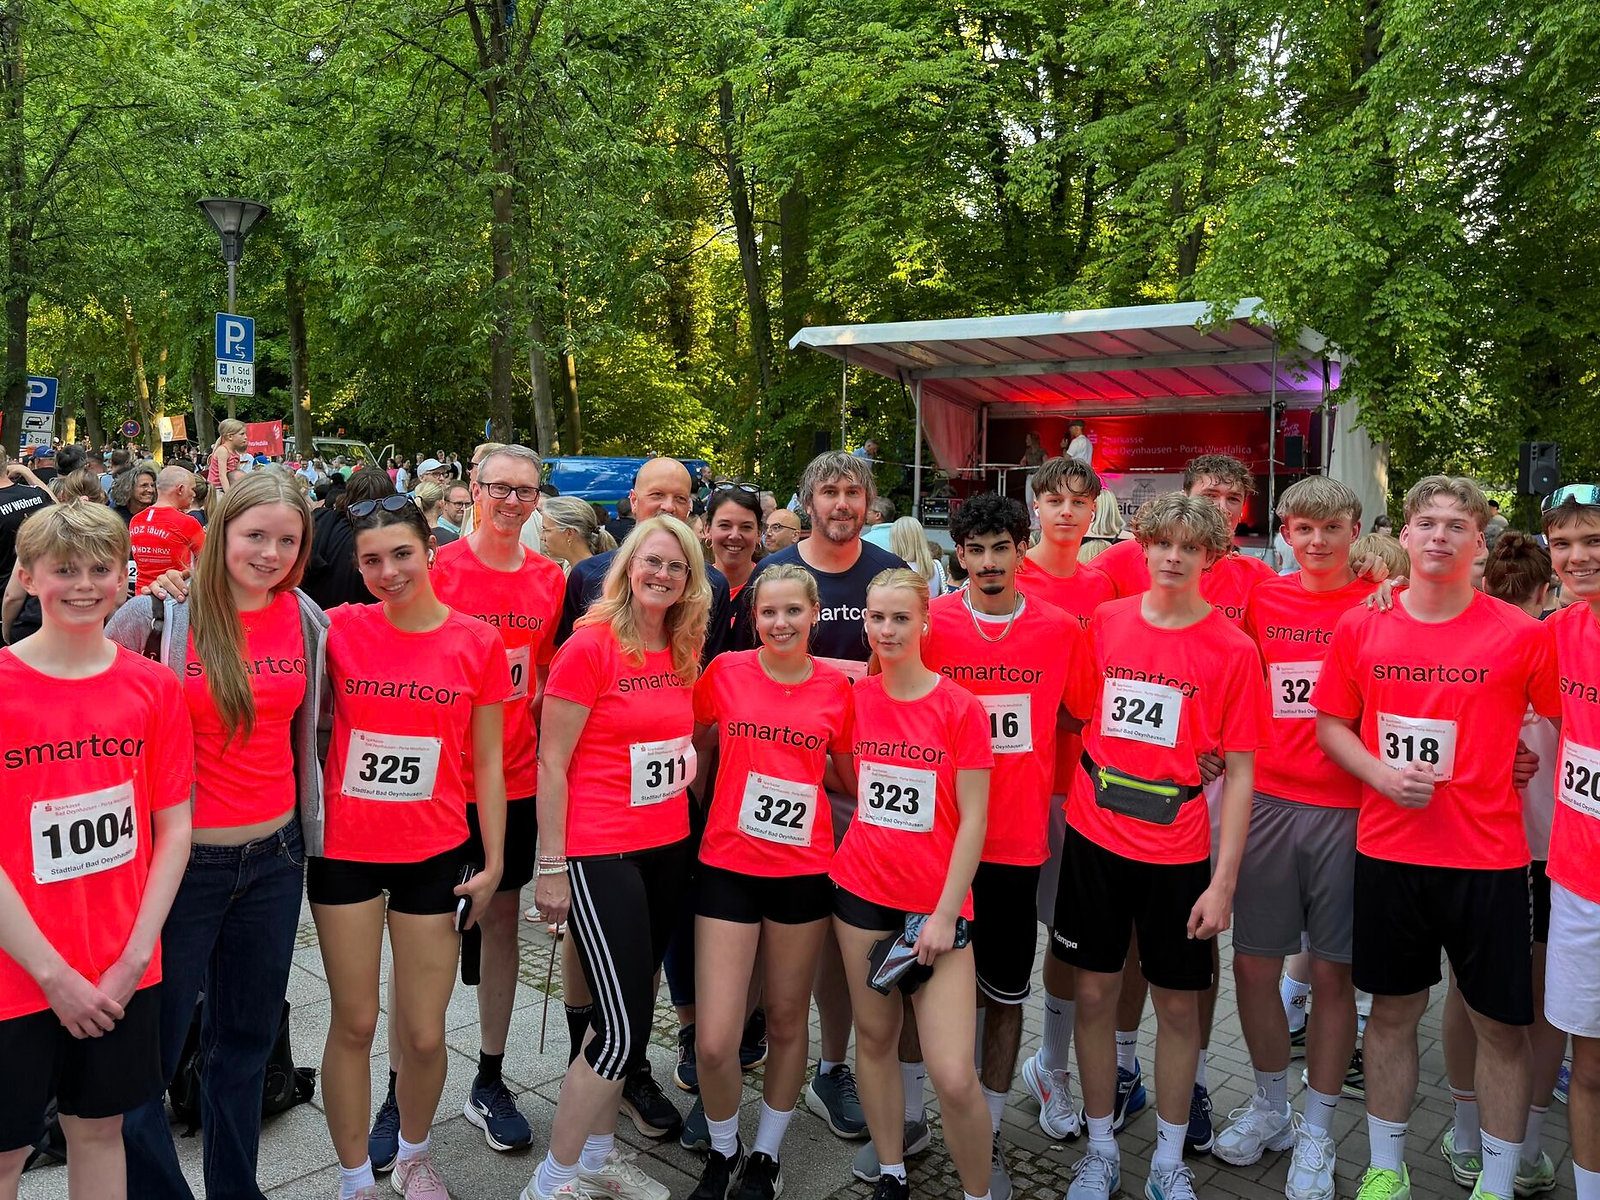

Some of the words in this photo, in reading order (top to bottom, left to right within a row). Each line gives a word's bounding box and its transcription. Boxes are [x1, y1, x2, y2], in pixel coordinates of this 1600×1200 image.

[226, 320, 245, 354] P
[220, 377, 251, 386] werktags
[232, 366, 234, 374] 1
[26, 380, 48, 406] P
[1119, 446, 1172, 456] Oeynhausen
[1180, 444, 1201, 454] Porta
[1204, 445, 1252, 454] Westfalica
[0, 503, 12, 515] HV
[11, 496, 43, 510] Wöhren
[1118, 502, 1138, 516] eitz
[129, 567, 138, 577] 2
[472, 611, 544, 630] artcor
[817, 604, 868, 621] artco
[1266, 626, 1333, 644] smartc
[186, 656, 306, 676] srtco
[941, 664, 1044, 684] smartcor
[1373, 664, 1490, 684] smartcor
[344, 678, 461, 706] smartcor
[618, 670, 685, 692] smartc
[1106, 666, 1200, 699] smartcor
[1282, 679, 1316, 703] 32
[1560, 677, 1600, 703] sma
[1112, 696, 1163, 728] 324
[728, 722, 825, 750] smartcor
[990, 712, 1018, 738] 16
[4, 734, 144, 769] smartcor
[854, 741, 946, 764] smartcor
[1386, 732, 1439, 765] 318
[359, 753, 420, 784] 325
[646, 755, 686, 788] 311
[388, 790, 422, 798] Oeynhausen
[869, 782, 919, 814] 323
[754, 795, 807, 829] 322
[42, 806, 134, 859] 1004
[50, 864, 84, 875] Stadtlauf
[86, 859, 99, 868] Bad
